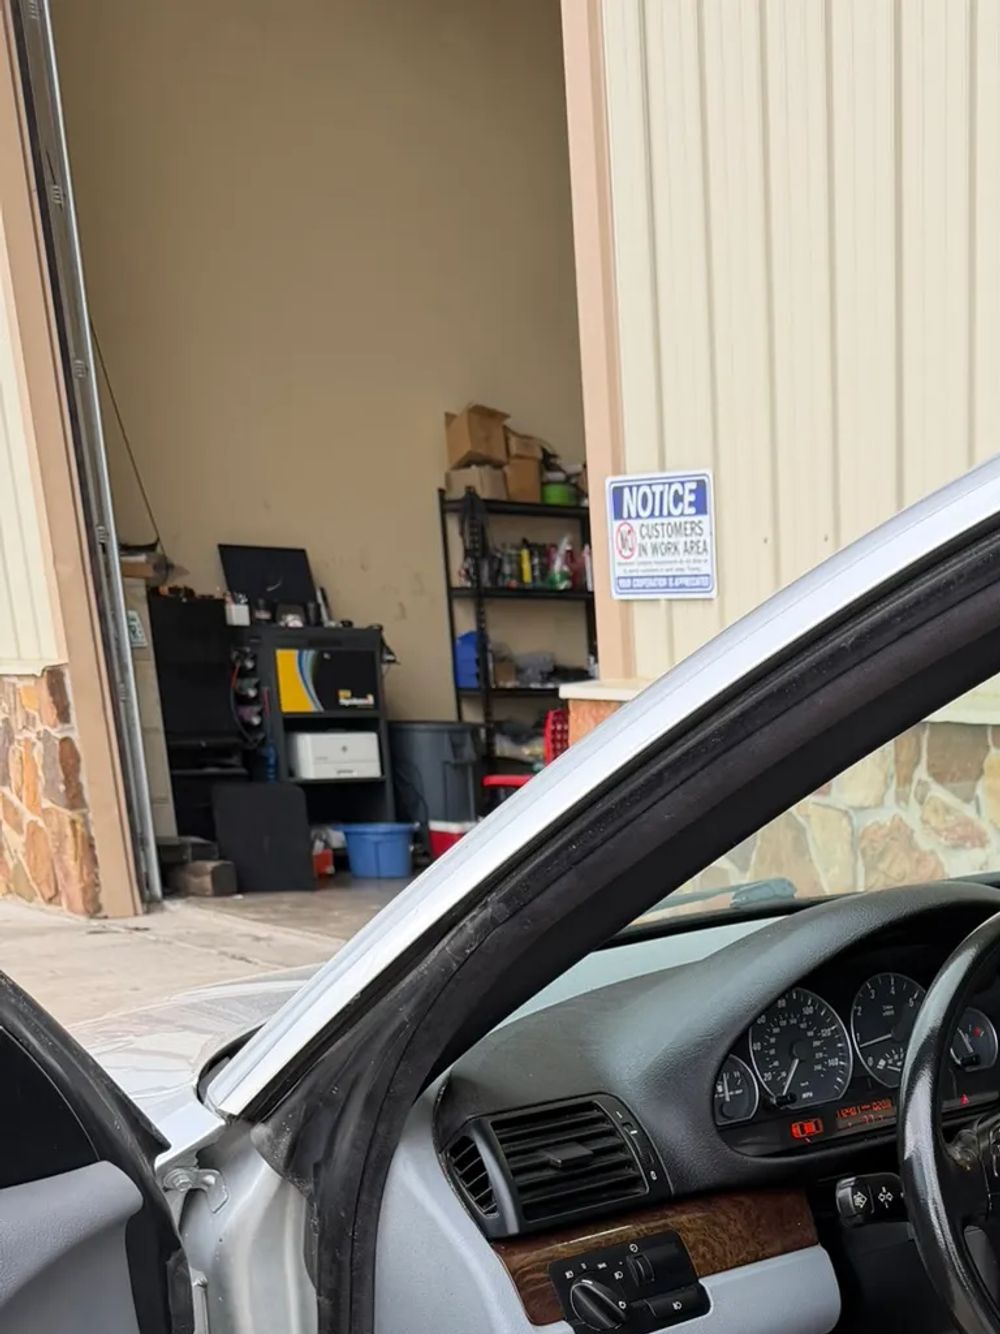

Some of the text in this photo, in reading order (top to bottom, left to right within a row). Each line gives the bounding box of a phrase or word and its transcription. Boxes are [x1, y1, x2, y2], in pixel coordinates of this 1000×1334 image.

[622, 481, 698, 520] NOTICE
[639, 520, 704, 540] CUSTOMERS
[639, 540, 708, 558] IN WORK AREA
